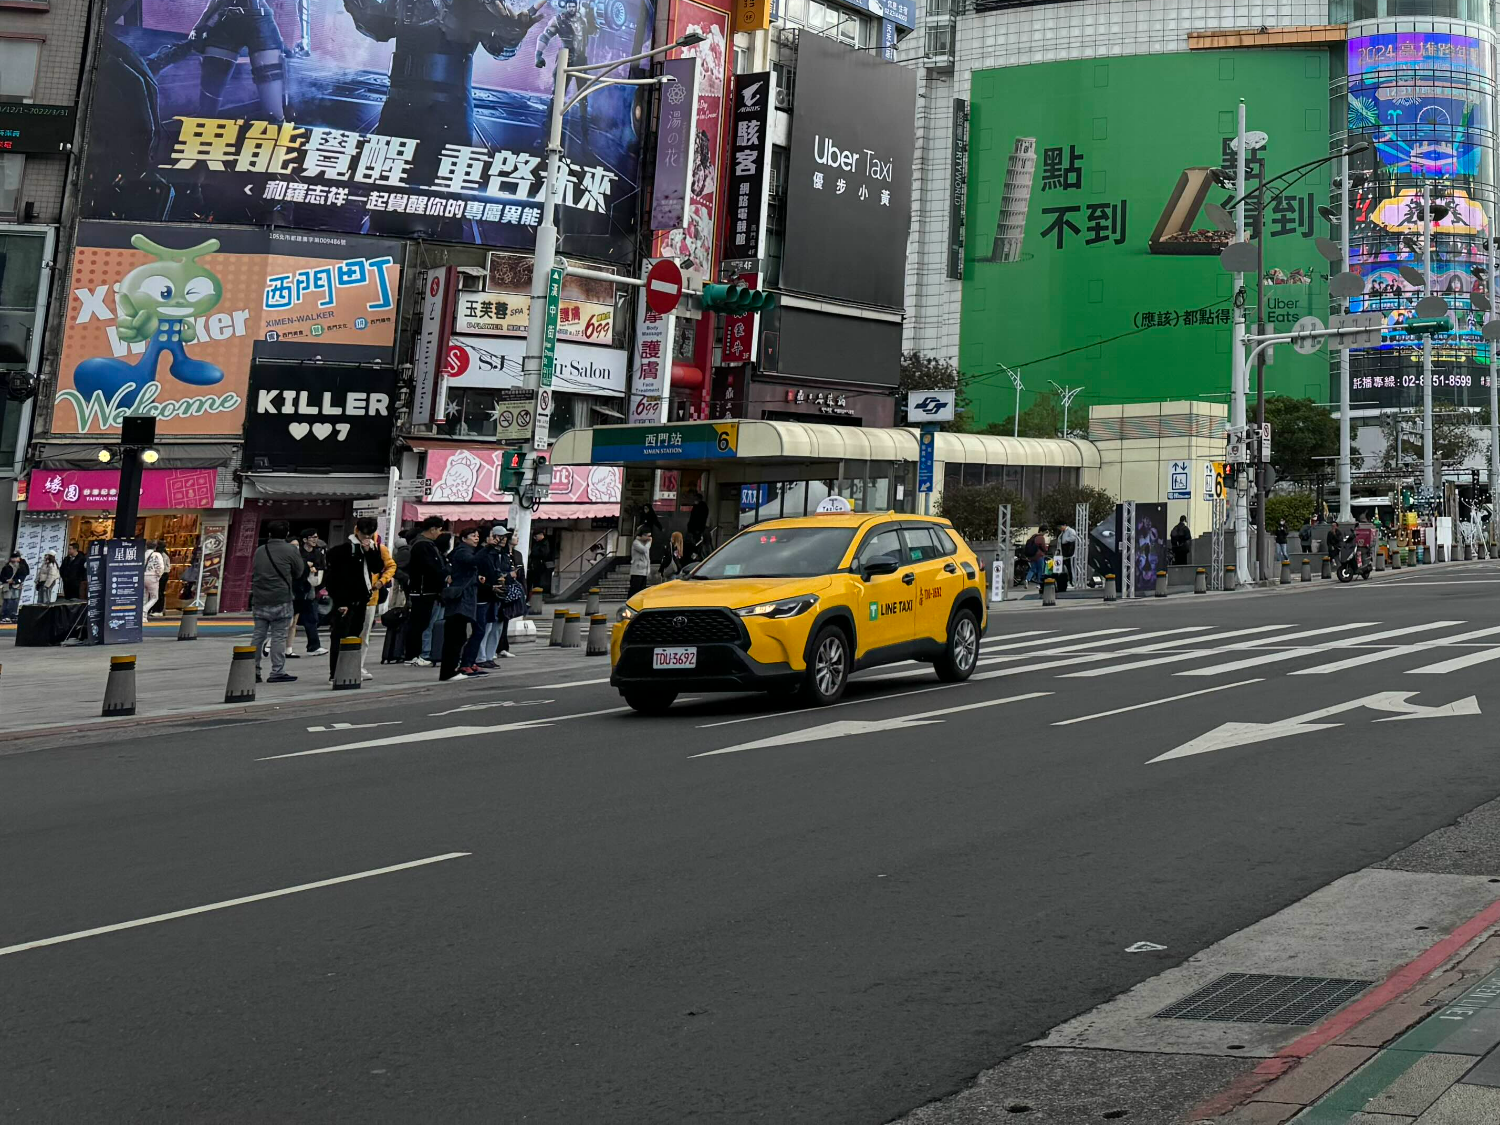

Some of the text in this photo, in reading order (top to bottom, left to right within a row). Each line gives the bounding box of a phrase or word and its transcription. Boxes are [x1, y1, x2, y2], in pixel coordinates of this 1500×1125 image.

[158, 115, 421, 186] 異能覺醒
[735, 121, 761, 176] 駭客
[814, 135, 893, 183] Uber Taxi
[1041, 144, 1084, 192] 點
[812, 172, 891, 207] 優步小黃
[262, 180, 543, 226] 和羅志祥一起覺醒你的專屬異能
[1040, 199, 1128, 250] 不到
[263, 257, 393, 311] 西門町
[464, 300, 508, 320] 玉芙蓉
[510, 308, 524, 316] SPA
[1267, 298, 1300, 309] Uber
[1268, 310, 1299, 323] Eats
[265, 311, 335, 328] XIMEN-WALKER
[1133, 307, 1247, 329] (應該)都點得
[570, 360, 611, 380] Salon
[638, 339, 661, 380] 護膚
[54, 381, 241, 434] Welcome
[257, 389, 389, 417] KILLER
[645, 431, 683, 447] 西門站
[716, 431, 730, 452] 6
[1215, 472, 1223, 498] 6
[114, 547, 137, 561] 星願
[880, 602, 897, 616] LINE
[898, 600, 913, 613] TAXI
[655, 652, 695, 665] TDU-3692
